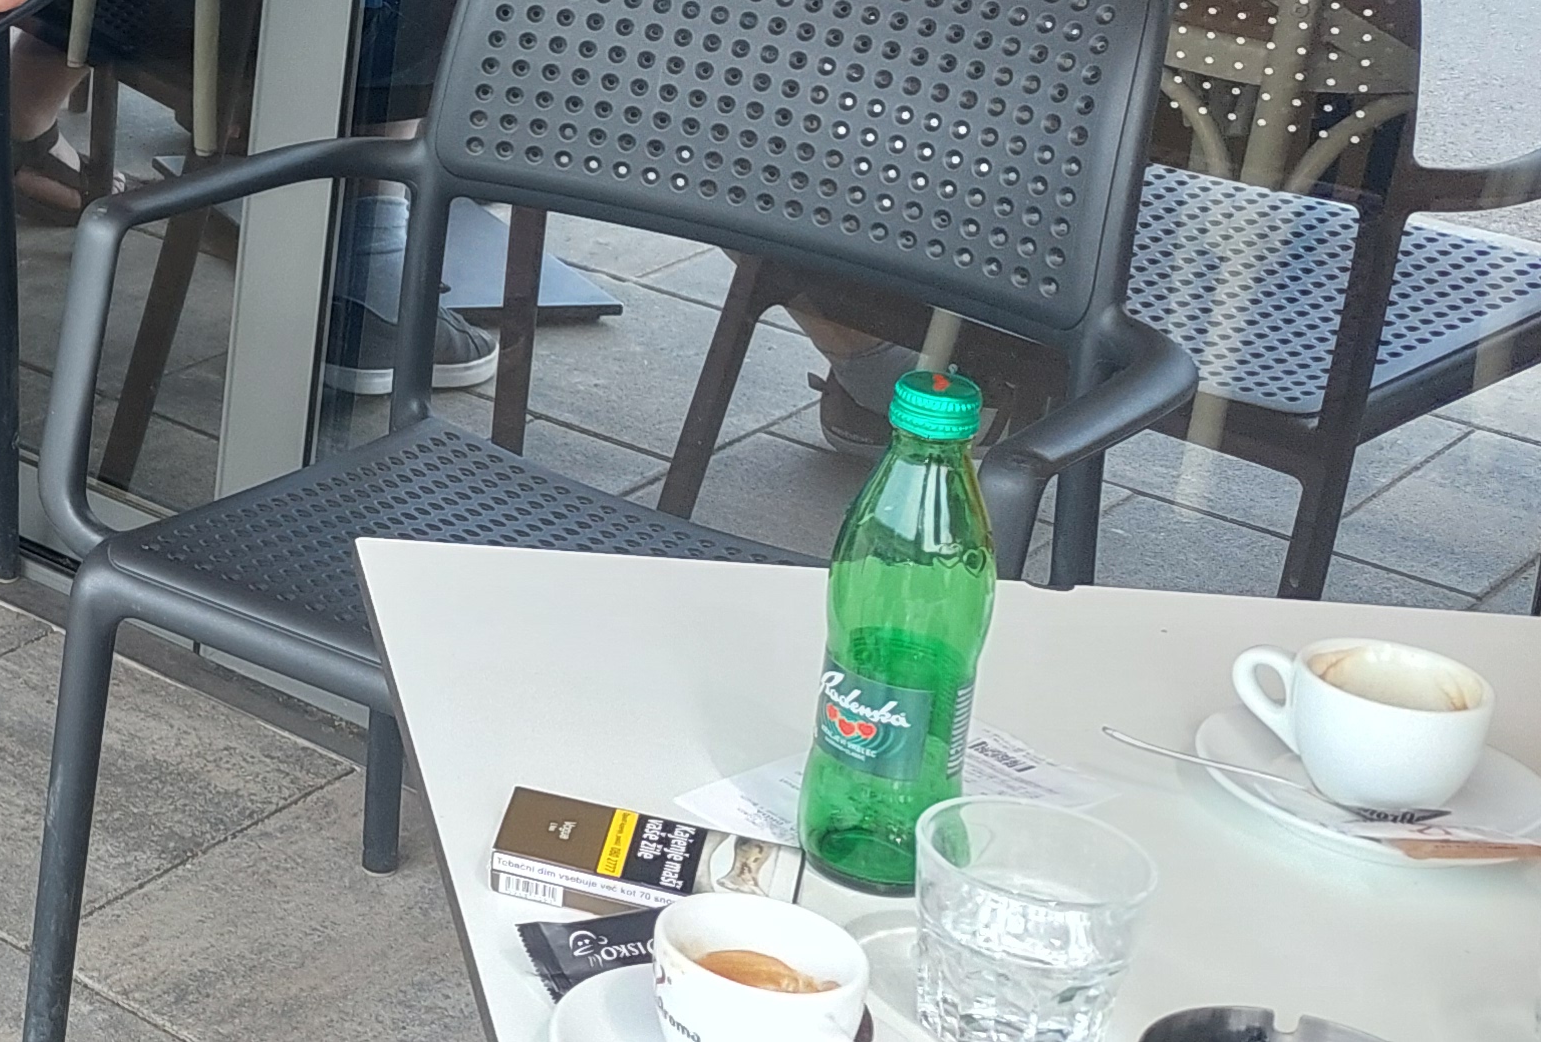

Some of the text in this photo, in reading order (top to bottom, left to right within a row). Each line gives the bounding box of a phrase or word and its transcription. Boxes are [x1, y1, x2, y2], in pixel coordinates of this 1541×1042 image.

[817, 670, 912, 728] Radenska
[637, 819, 667, 860] vaše žile
[659, 824, 696, 890] Kajenje maši
[537, 867, 556, 878] dim
[558, 872, 597, 889] vsebuje
[600, 881, 618, 893] več
[620, 887, 637, 898] kot
[639, 890, 652, 902] 70
[653, 894, 678, 906] sno
